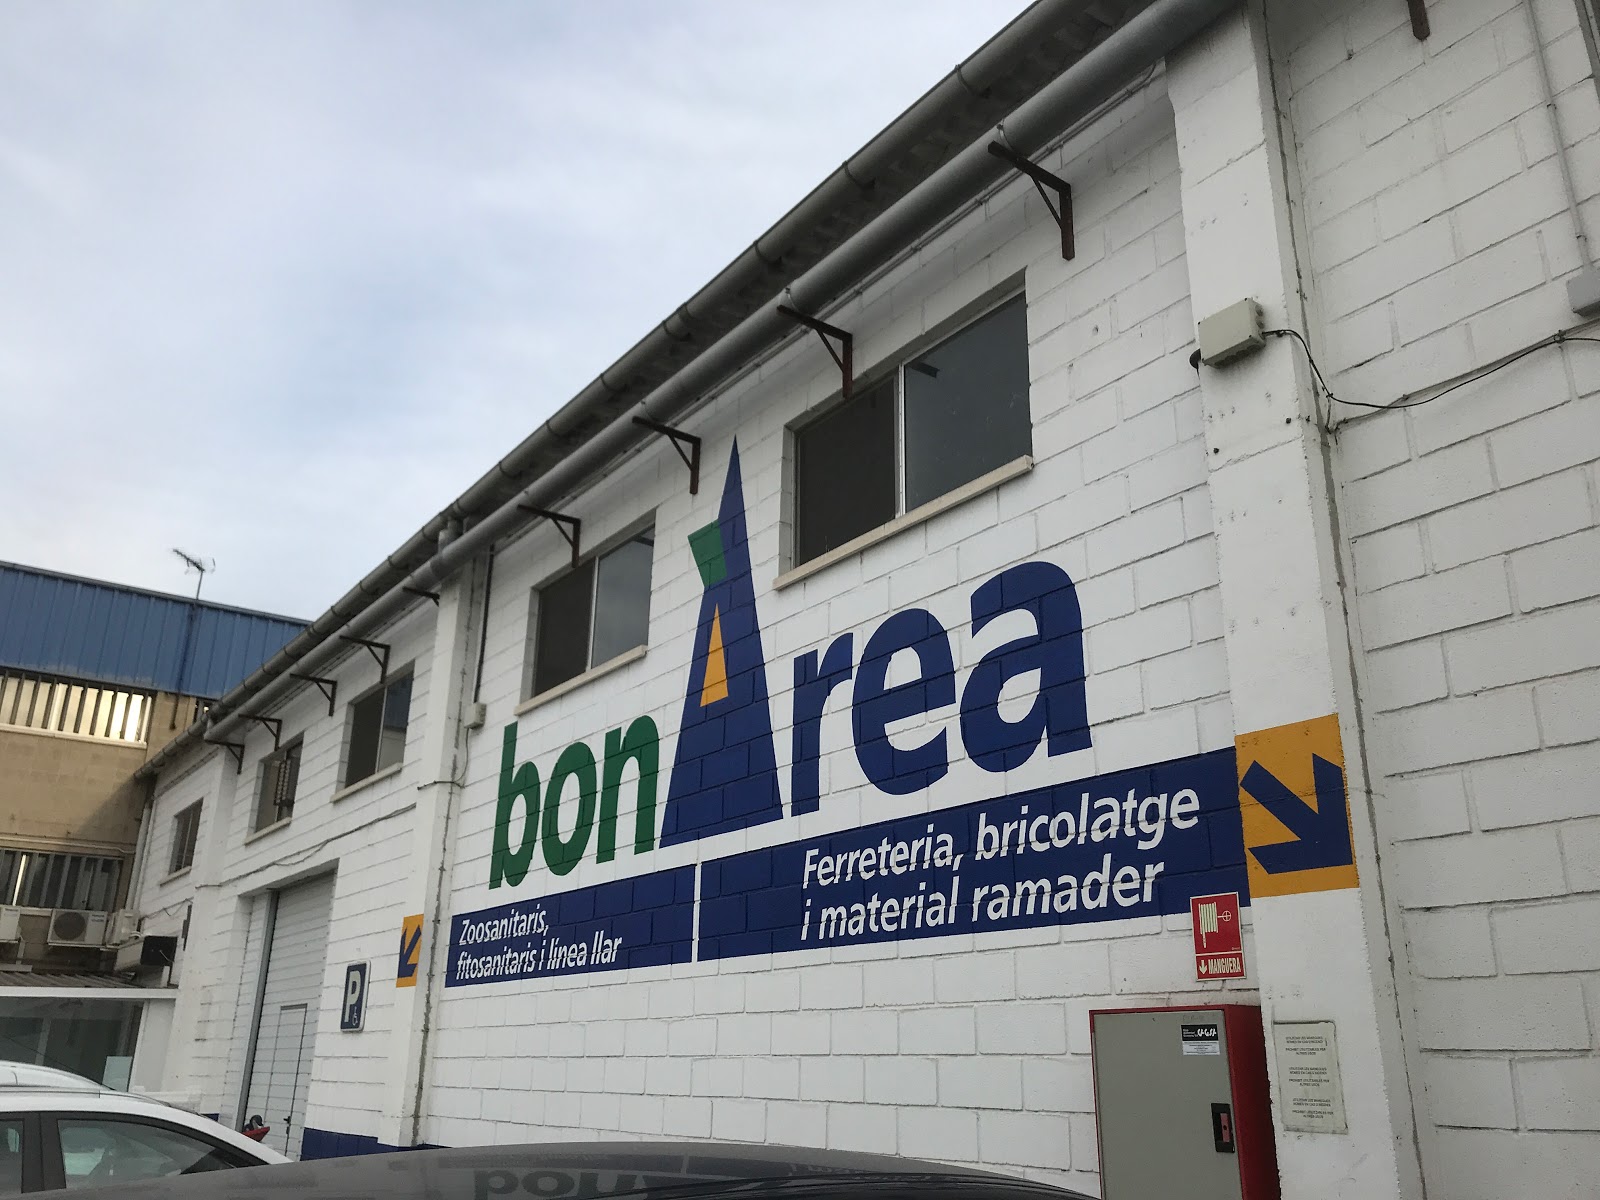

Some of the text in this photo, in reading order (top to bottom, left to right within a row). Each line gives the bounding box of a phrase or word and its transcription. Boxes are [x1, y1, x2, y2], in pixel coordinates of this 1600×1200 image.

[803, 788, 1200, 889] Ferreteria, bricolatge
[801, 853, 1165, 940] i material ramader
[458, 903, 549, 946] Zoosanitaris,
[456, 941, 538, 980] fitosanitaris
[538, 939, 547, 971] i
[590, 930, 622, 965] llar
[1208, 957, 1242, 974] MANGUERA
[344, 970, 361, 1023] P
